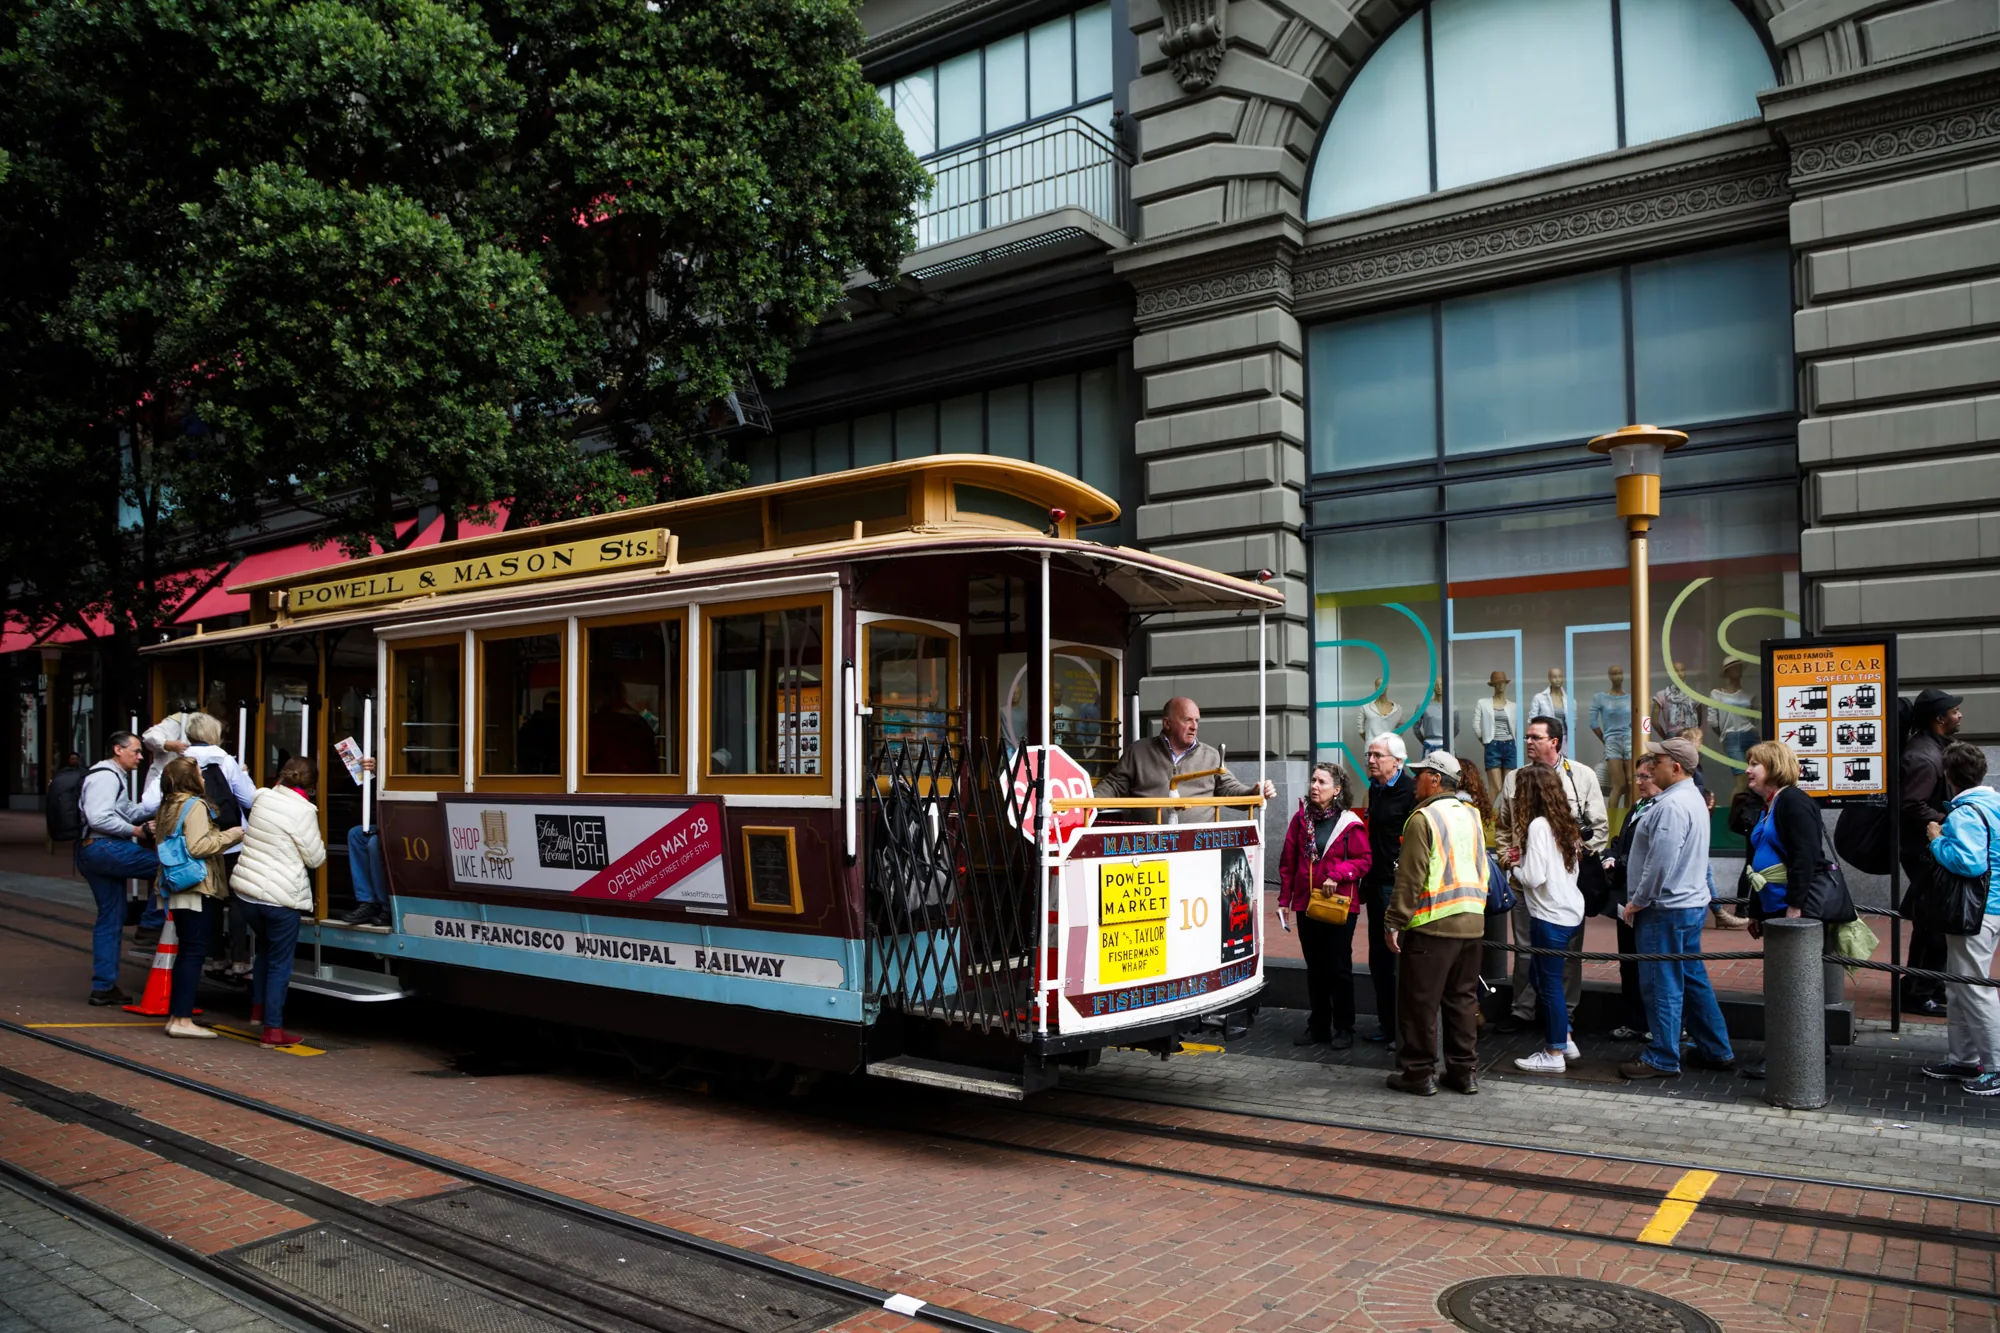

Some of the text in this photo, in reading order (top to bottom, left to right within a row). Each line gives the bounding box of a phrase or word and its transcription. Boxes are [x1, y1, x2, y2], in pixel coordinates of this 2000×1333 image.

[298, 539, 654, 605] POWELL & MASON Sts.
[1777, 658, 1881, 675] CABLE CAR
[1816, 673, 1881, 683] SAFETY TIPS
[452, 827, 480, 850] SHOP
[574, 821, 602, 843] OFF
[1103, 835, 1180, 856] MARKET
[1193, 829, 1241, 850] STREET
[401, 836, 429, 861] 10
[576, 843, 606, 865] 5TH
[607, 817, 709, 895] OPENING MAY 28
[455, 855, 513, 880] LIKE A PRO
[636, 874, 659, 893] MARKET
[659, 859, 680, 879] STREET
[1106, 871, 1166, 888] POWELL
[1122, 887, 1152, 899] AND
[1105, 897, 1167, 915] MARKET
[1180, 896, 1209, 931] 10
[1102, 931, 1119, 948] BAY
[1134, 925, 1165, 944] TAYLOR
[434, 919, 785, 978] SAN FRANCISCO MUNICIPAL RAILWAY
[1108, 945, 1159, 963] FISHERMANS
[1121, 959, 1148, 973] WHARF
[1093, 961, 1253, 1015] FISHERMANS WHARF
